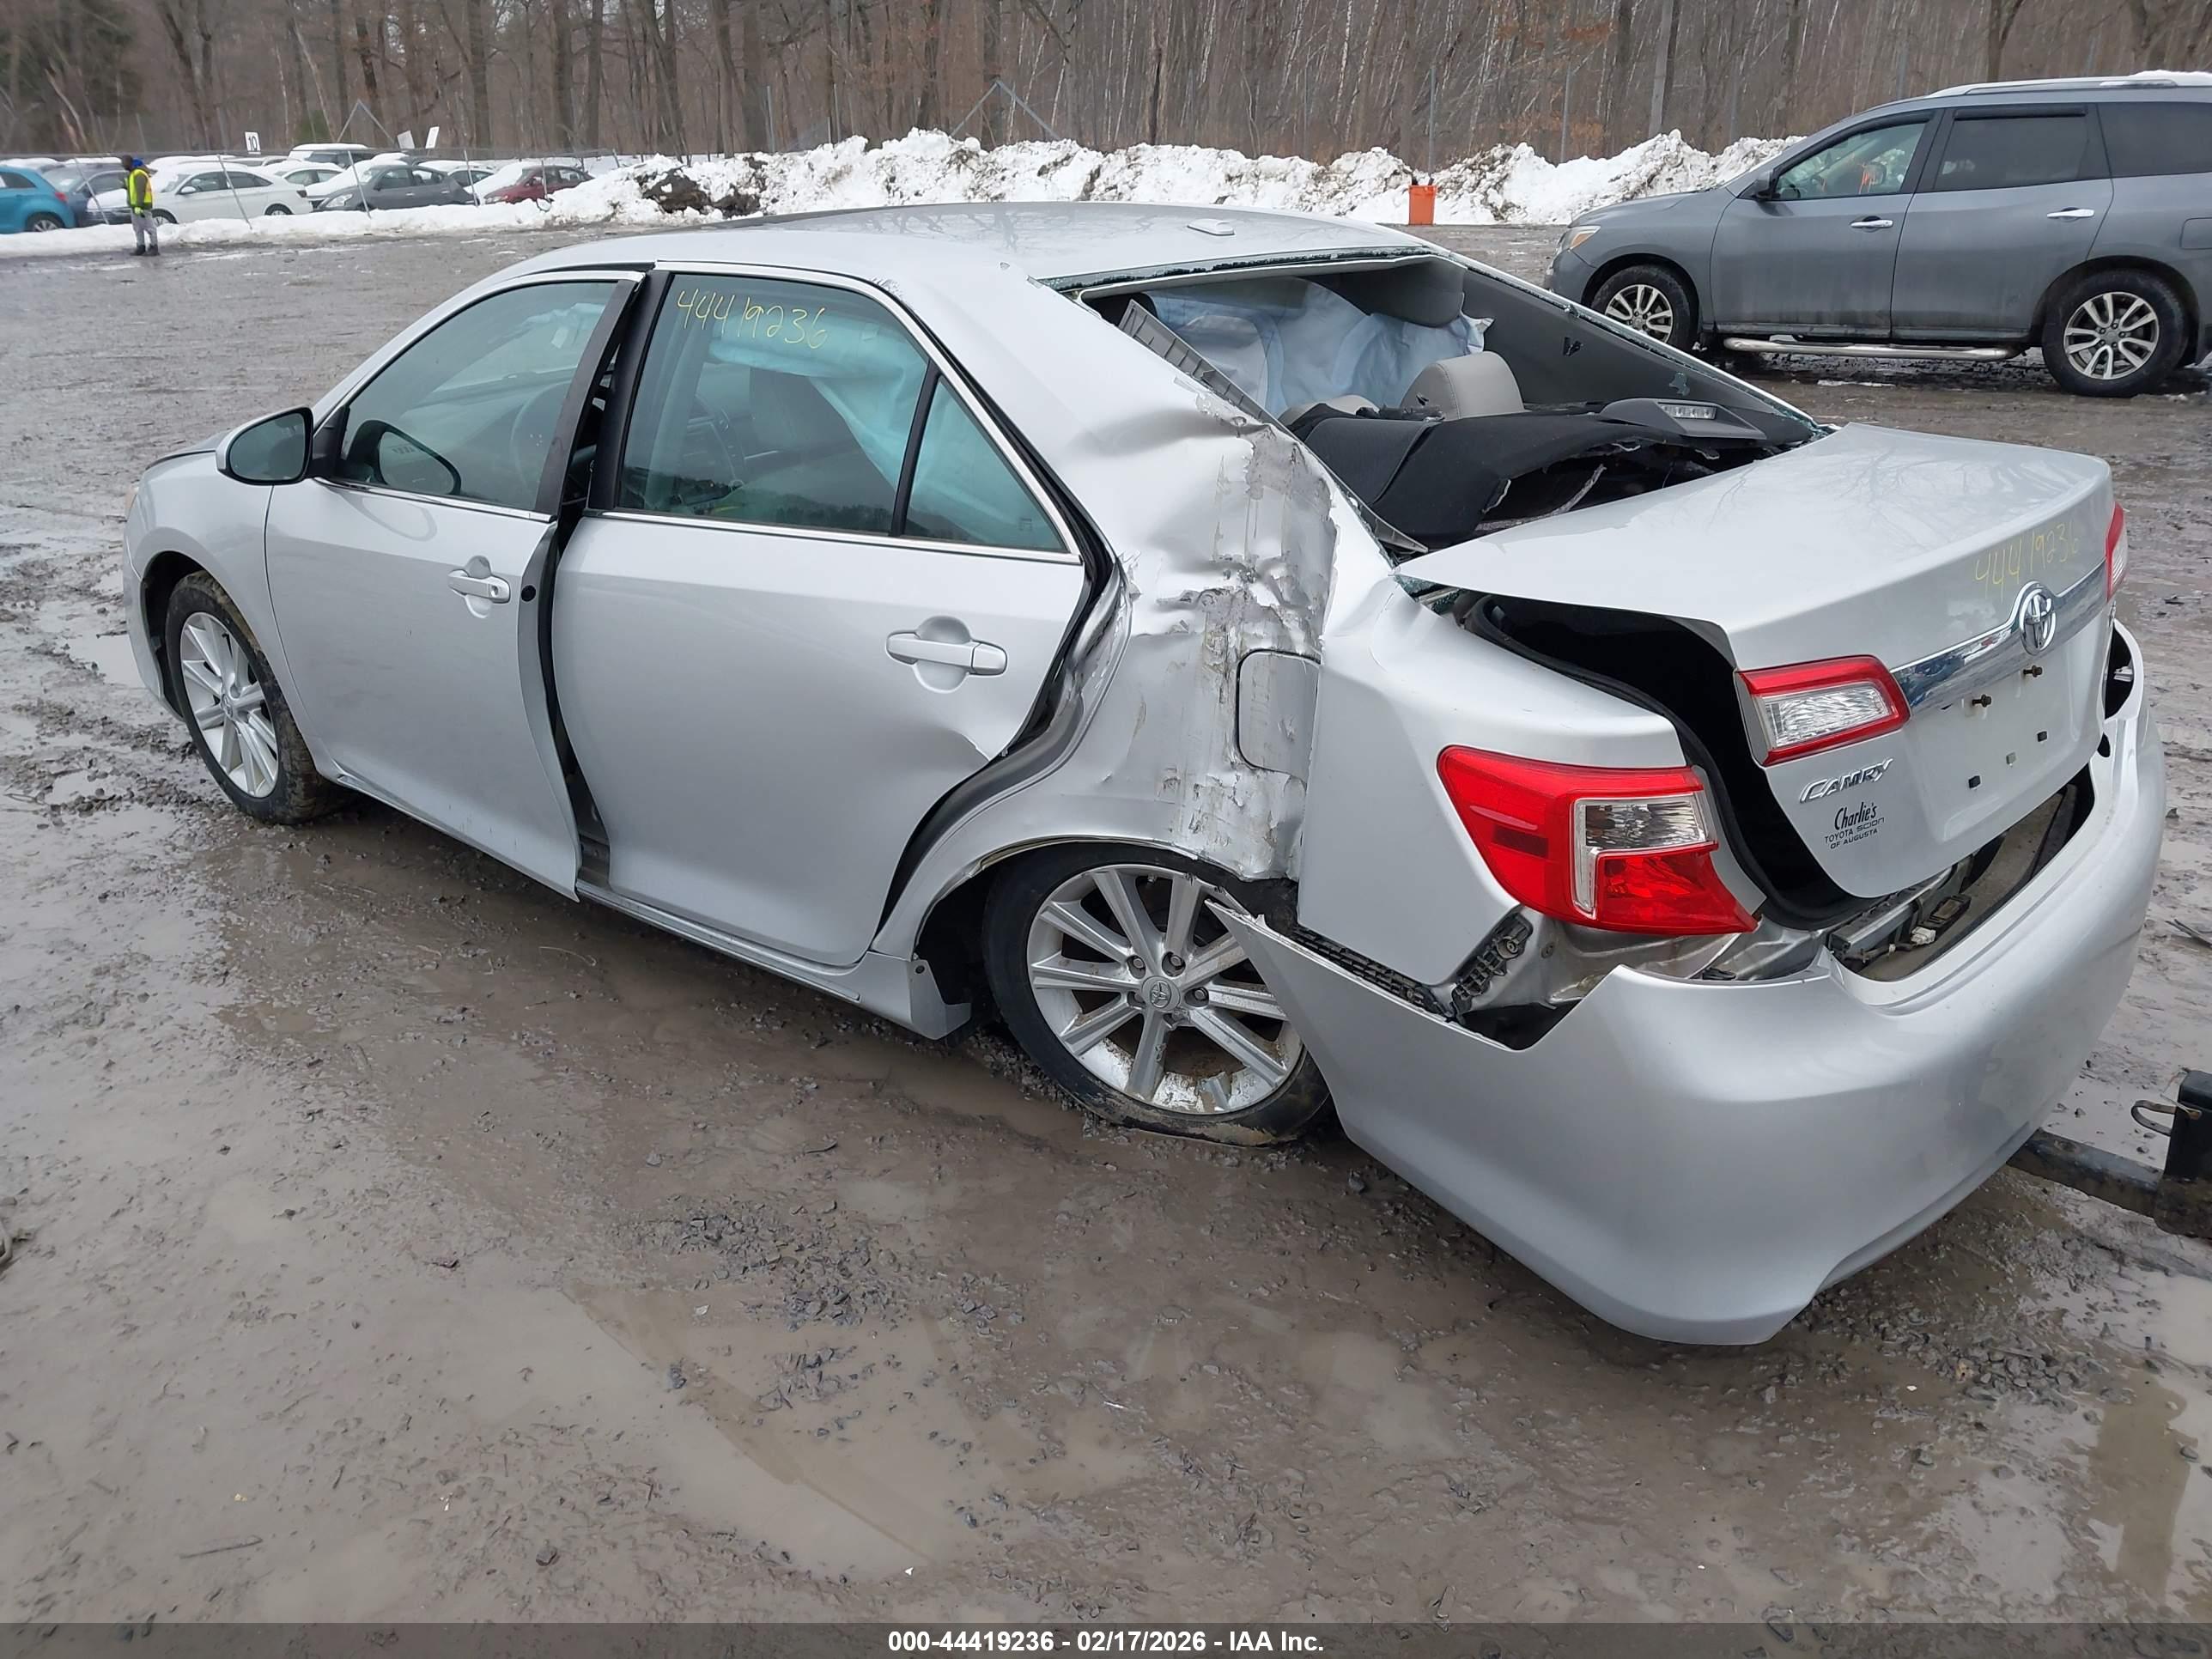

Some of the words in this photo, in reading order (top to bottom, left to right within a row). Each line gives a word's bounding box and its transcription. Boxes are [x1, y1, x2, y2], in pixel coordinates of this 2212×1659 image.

[248, 136, 258, 152] 10
[1799, 757, 1893, 804] CAMRY
[1834, 801, 1878, 830] Charlie's
[1825, 828, 1854, 843] TOYOTA
[1830, 841, 1841, 850] OF
[1843, 828, 1878, 846] AUGUSTA
